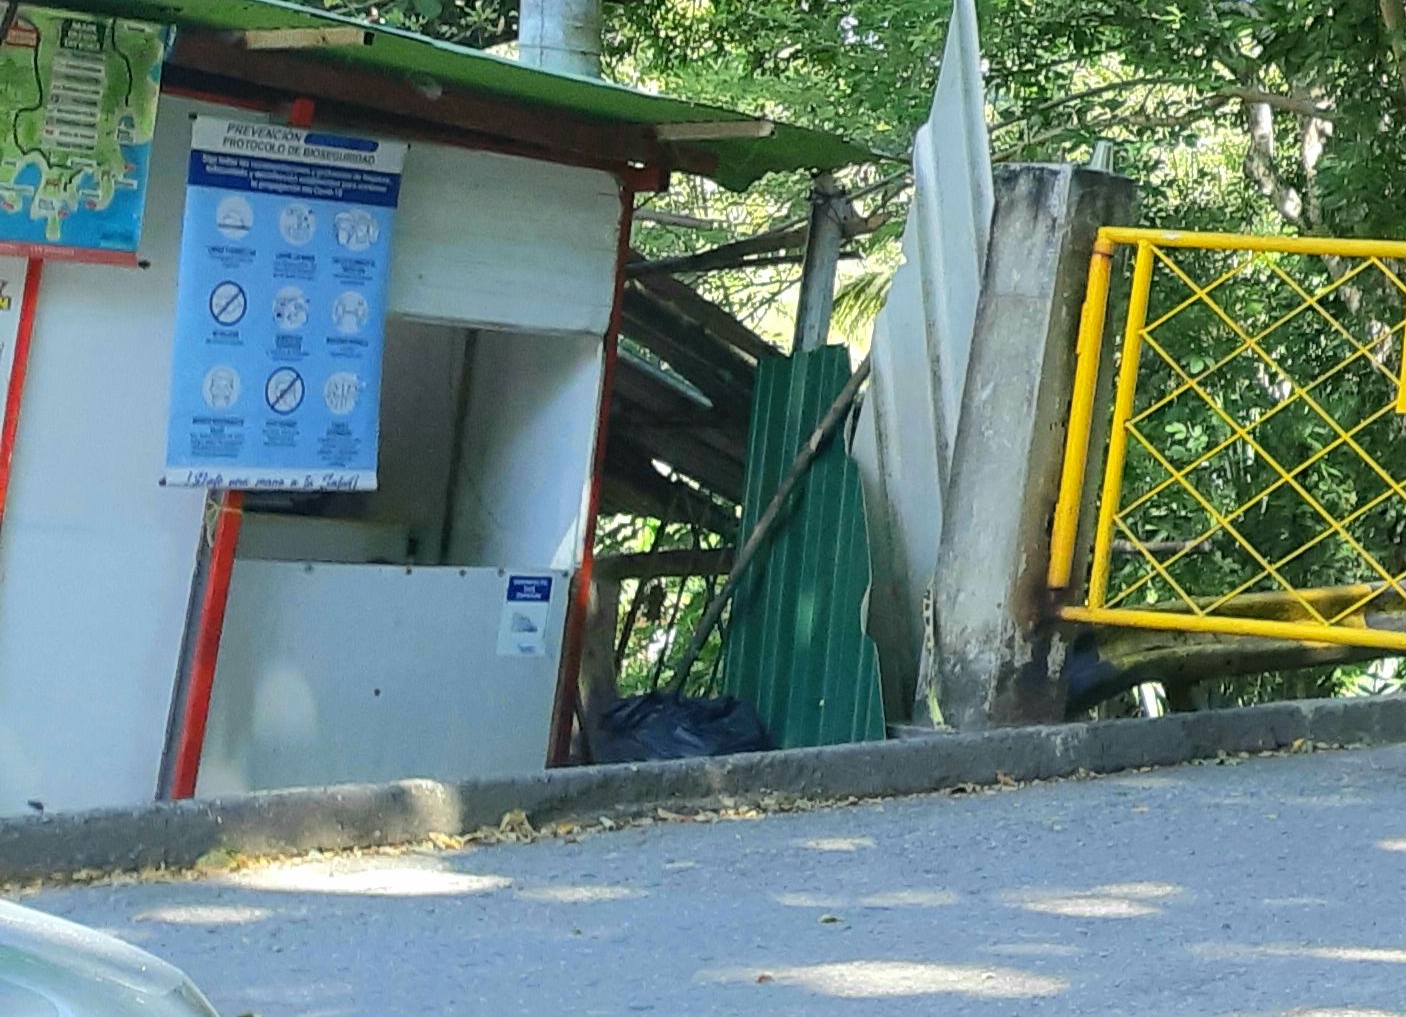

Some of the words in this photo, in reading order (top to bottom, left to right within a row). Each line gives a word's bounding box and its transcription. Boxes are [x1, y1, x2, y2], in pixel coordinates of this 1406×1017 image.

[226, 122, 301, 142] PREVENCIÓN
[222, 137, 285, 154] PROTOCOLO
[288, 144, 300, 156] DE
[303, 147, 375, 165] BIOSEGURIDAD
